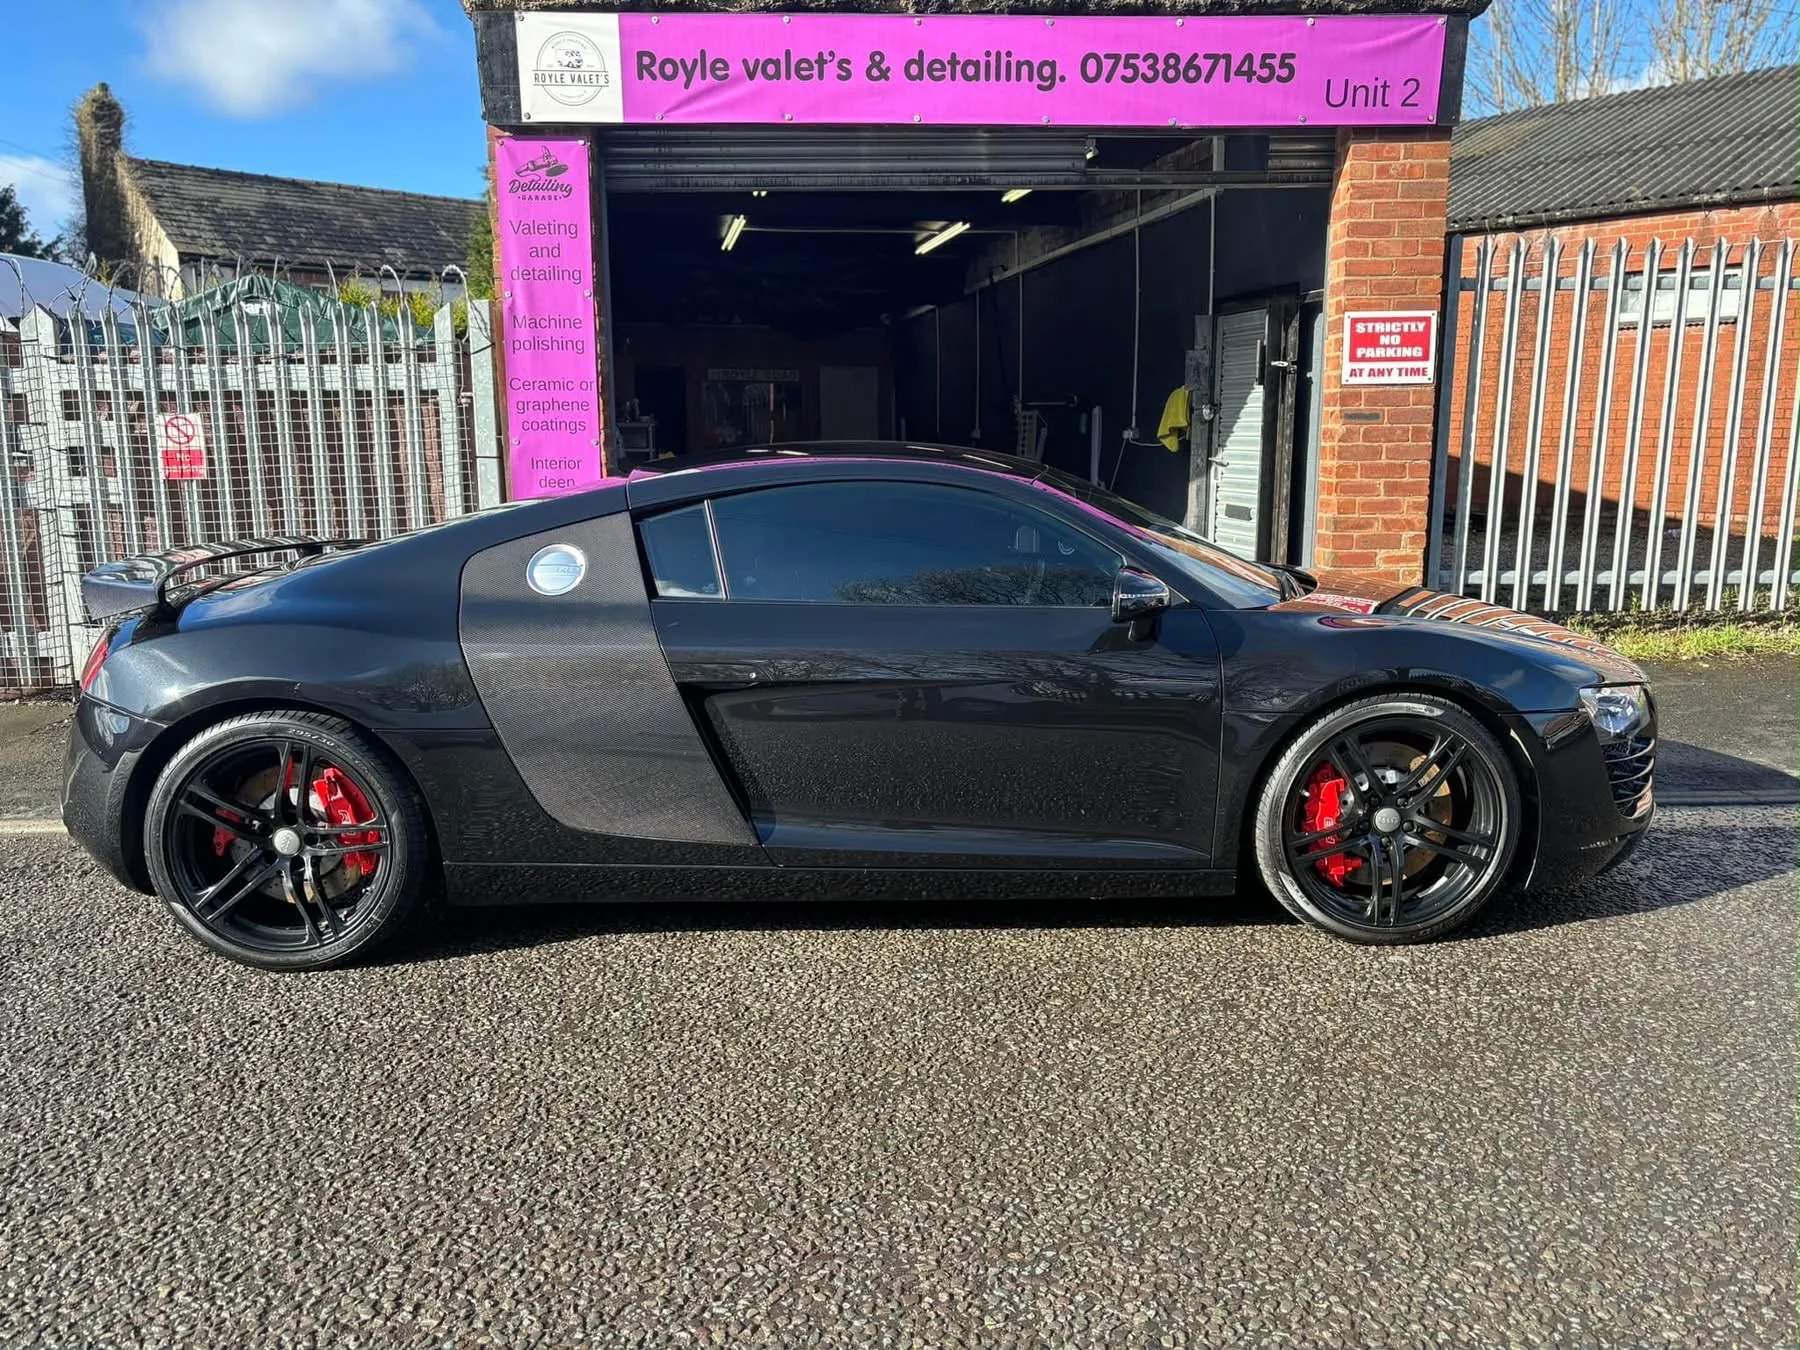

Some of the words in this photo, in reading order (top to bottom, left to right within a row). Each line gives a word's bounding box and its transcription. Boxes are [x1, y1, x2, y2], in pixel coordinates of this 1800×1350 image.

[636, 49, 730, 89] Royle
[742, 49, 853, 81] valet's
[865, 50, 891, 82] &
[903, 49, 1066, 91] detailing.
[1079, 52, 1297, 84] 07538671455
[534, 73, 565, 84] ROYLE
[570, 73, 610, 84] VALET'S
[1325, 77, 1391, 108] Unit
[1400, 78, 1421, 108] 2
[508, 179, 573, 198] Detailing
[509, 219, 578, 239] Valeting
[529, 243, 561, 258] and
[510, 265, 582, 285] detailing
[513, 314, 583, 329] Machine
[1355, 321, 1426, 333] STRICTLY
[512, 336, 585, 354] polishing
[1380, 334, 1401, 345] NO
[1356, 346, 1423, 358] PARKING
[1349, 368, 1365, 377] AT
[1368, 368, 1393, 377] ANY
[1397, 367, 1428, 376] TIME
[509, 377, 575, 391] Ceramic
[580, 380, 594, 391] or
[516, 398, 590, 414] graphene
[522, 417, 587, 435] coatings
[531, 457, 583, 470] Interior
